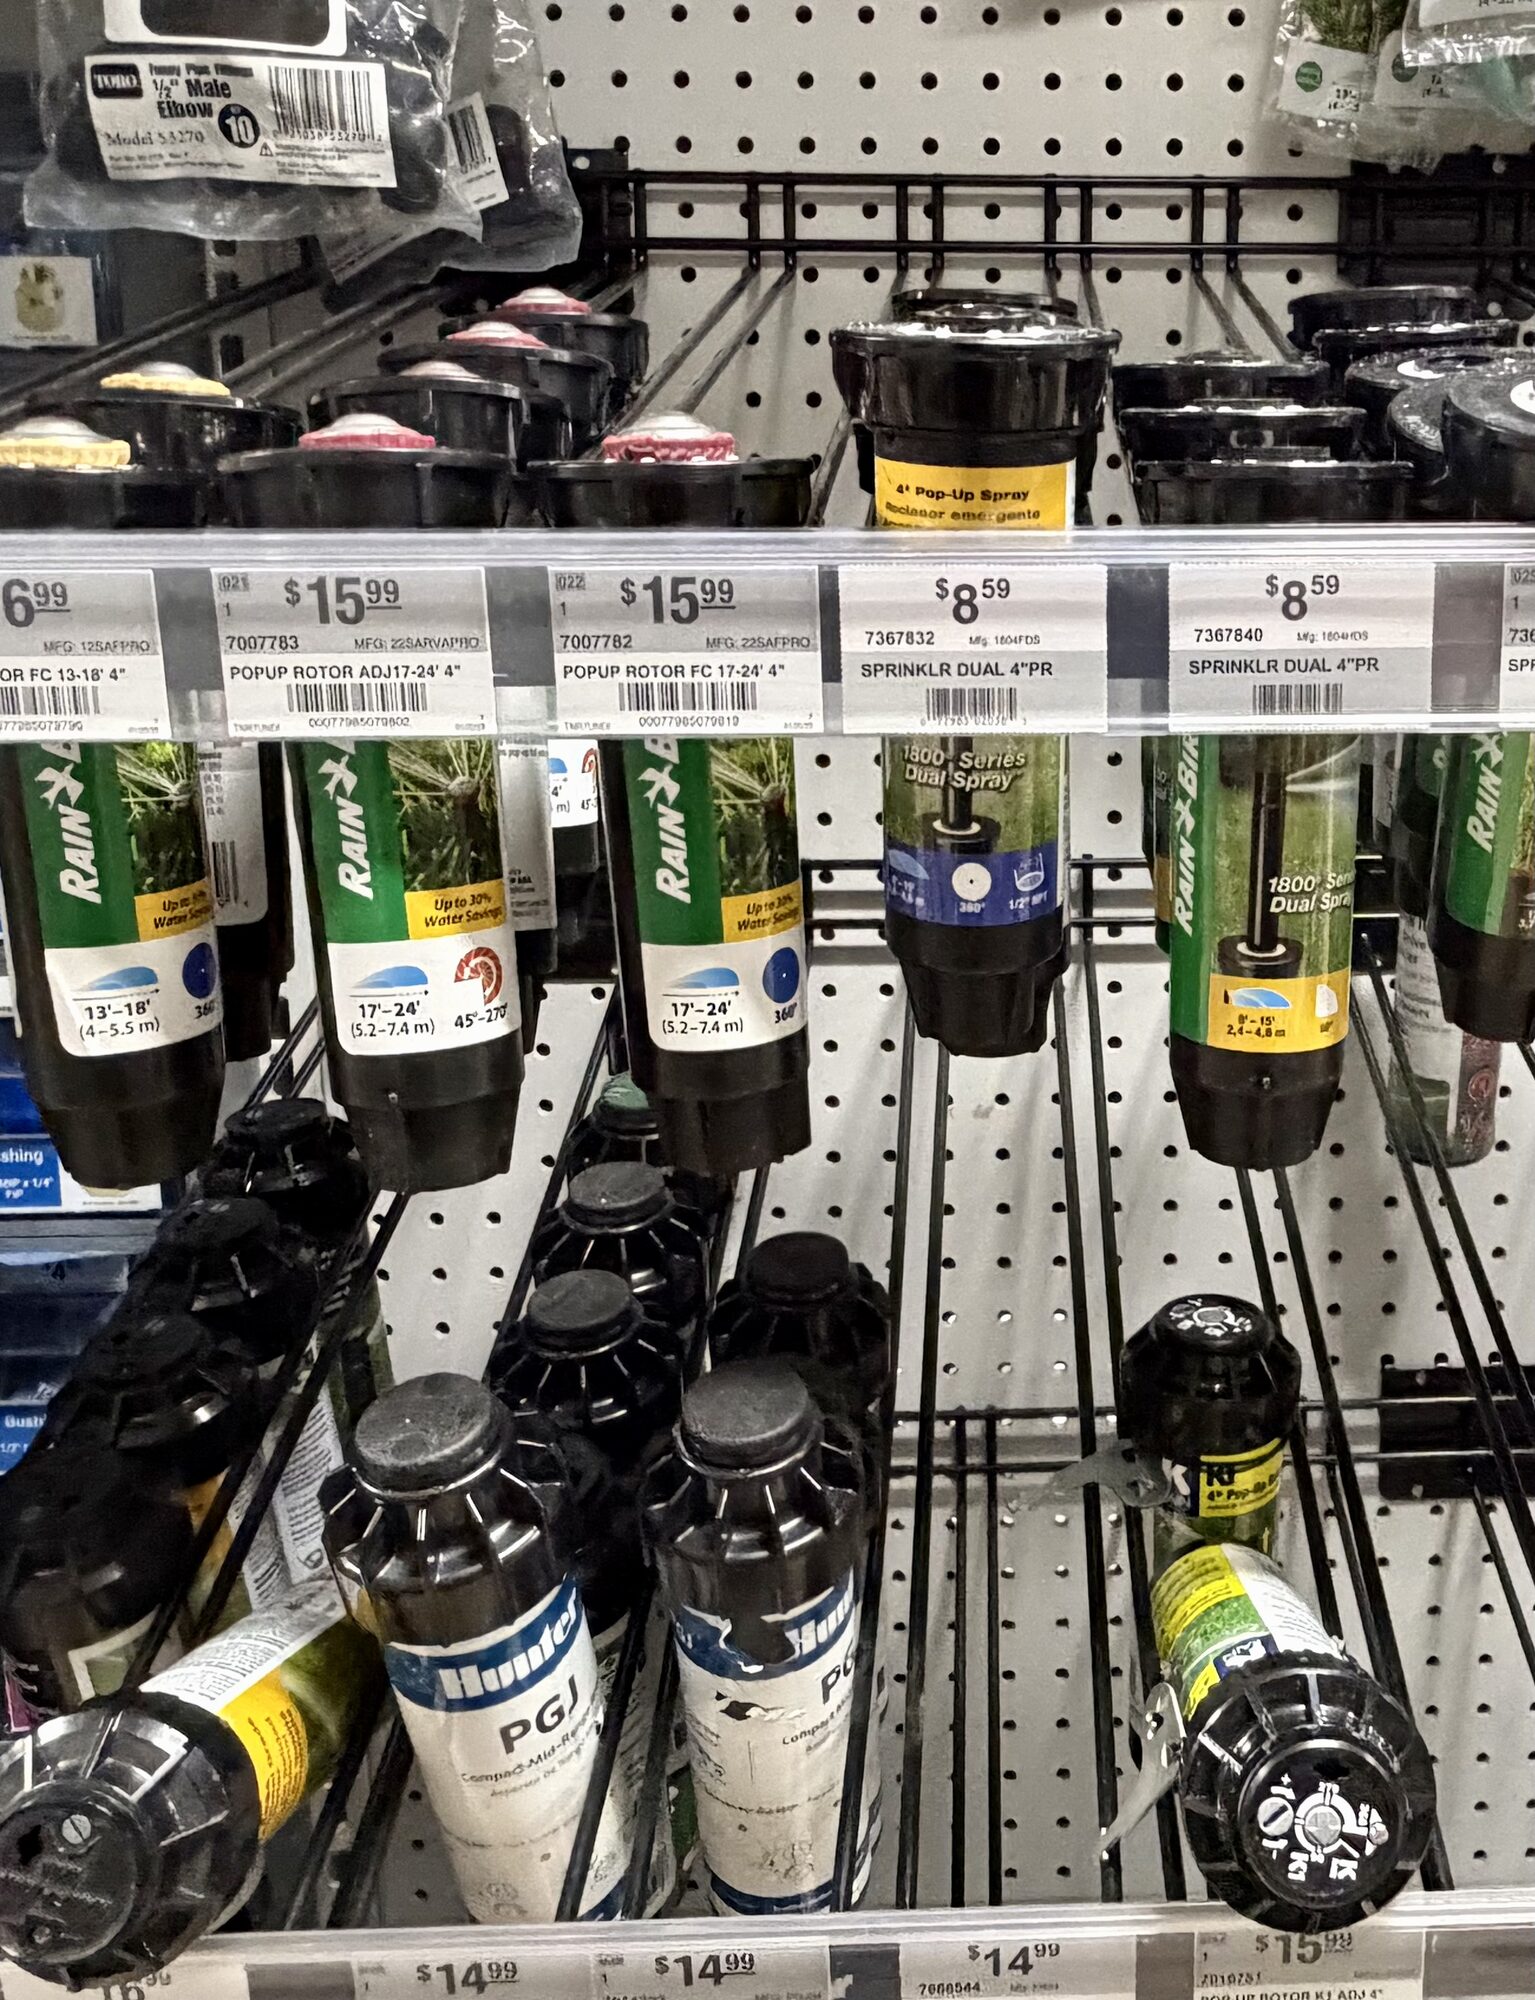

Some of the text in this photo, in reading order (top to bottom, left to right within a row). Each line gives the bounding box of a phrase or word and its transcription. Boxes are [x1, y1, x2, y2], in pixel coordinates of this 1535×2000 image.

[185, 79, 232, 98] Male
[157, 101, 213, 119] Elbow
[102, 130, 153, 146] Model
[225, 115, 255, 145] 10
[915, 486, 975, 501] Pop-Up
[980, 489, 1030, 502] Spray
[226, 635, 300, 650] 7007783
[560, 635, 811, 650] 7007782 MFG: 22SAFPRO
[865, 631, 936, 646] 7367832
[1194, 628, 1264, 643] 7367840
[30, 668, 52, 681] FC
[57, 668, 104, 681] 13-18'
[109, 667, 127, 681] 4"
[230, 665, 461, 681] POPUP ROTOR ADJ17-24' 4"
[563, 663, 786, 679] POPUP ROTOR FC 17-24' 4"
[861, 661, 1054, 678] SPRINKLR DUAL 4"PR
[1189, 658, 1380, 675] SPRINKLR DUAL 4"PR
[903, 745, 1027, 770] 1800 Series
[905, 763, 1013, 793] Dual Spray
[1466, 762, 1502, 855] RAIN
[1174, 735, 1199, 937] RAIN BIR
[59, 803, 102, 905] RAIN
[338, 796, 374, 901] RAIN
[656, 803, 692, 904] RAIN
[1268, 875, 1317, 894] 1800
[434, 898, 453, 911] Up
[454, 897, 467, 908] to
[746, 901, 762, 915] Up
[1269, 890, 1353, 914] Dual Spra
[425, 912, 463, 928] Water
[139, 1016, 161, 1034] m)
[414, 1017, 436, 1036] m)
[725, 1016, 744, 1034] m)
[820, 1638, 855, 1706] PG
[499, 1673, 580, 1756] PGJ
